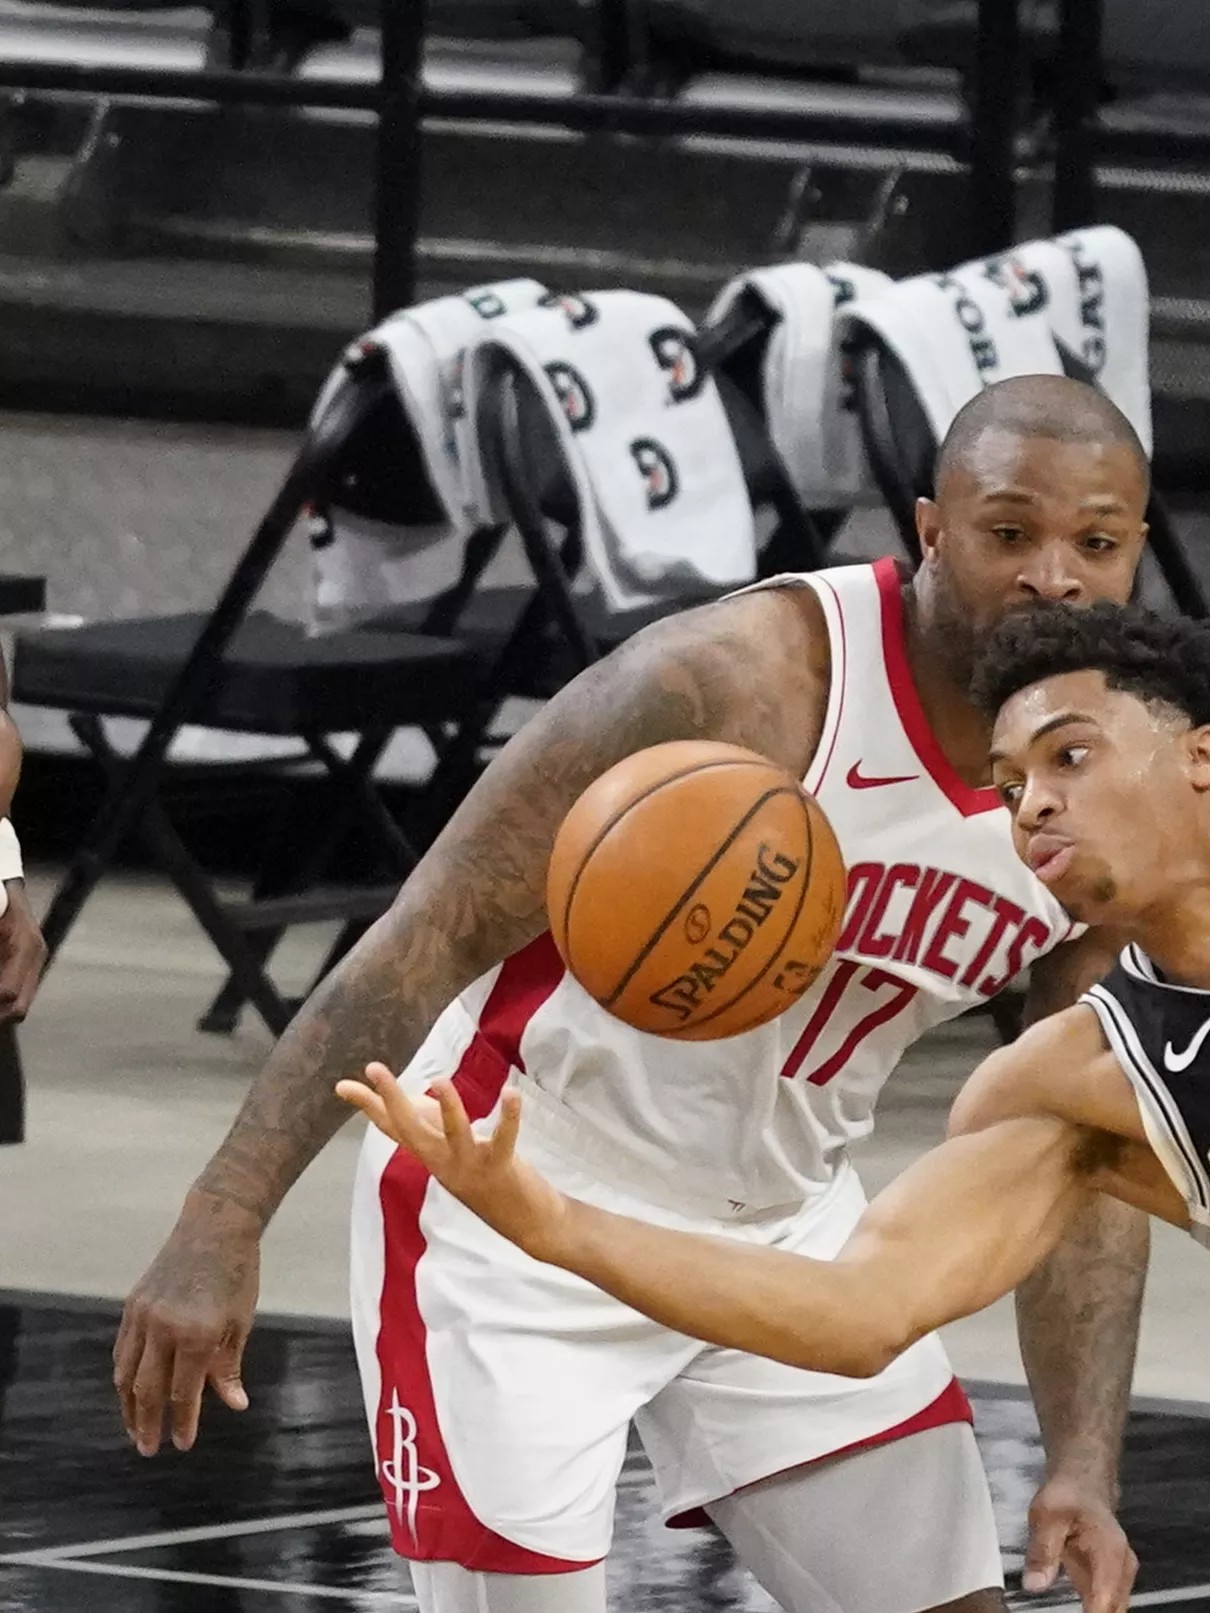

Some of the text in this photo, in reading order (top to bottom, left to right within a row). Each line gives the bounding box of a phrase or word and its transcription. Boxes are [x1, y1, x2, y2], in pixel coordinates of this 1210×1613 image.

[649, 839, 799, 1021] SPALDING
[836, 862, 1053, 997] OCKETS
[779, 958, 919, 1087] 17
